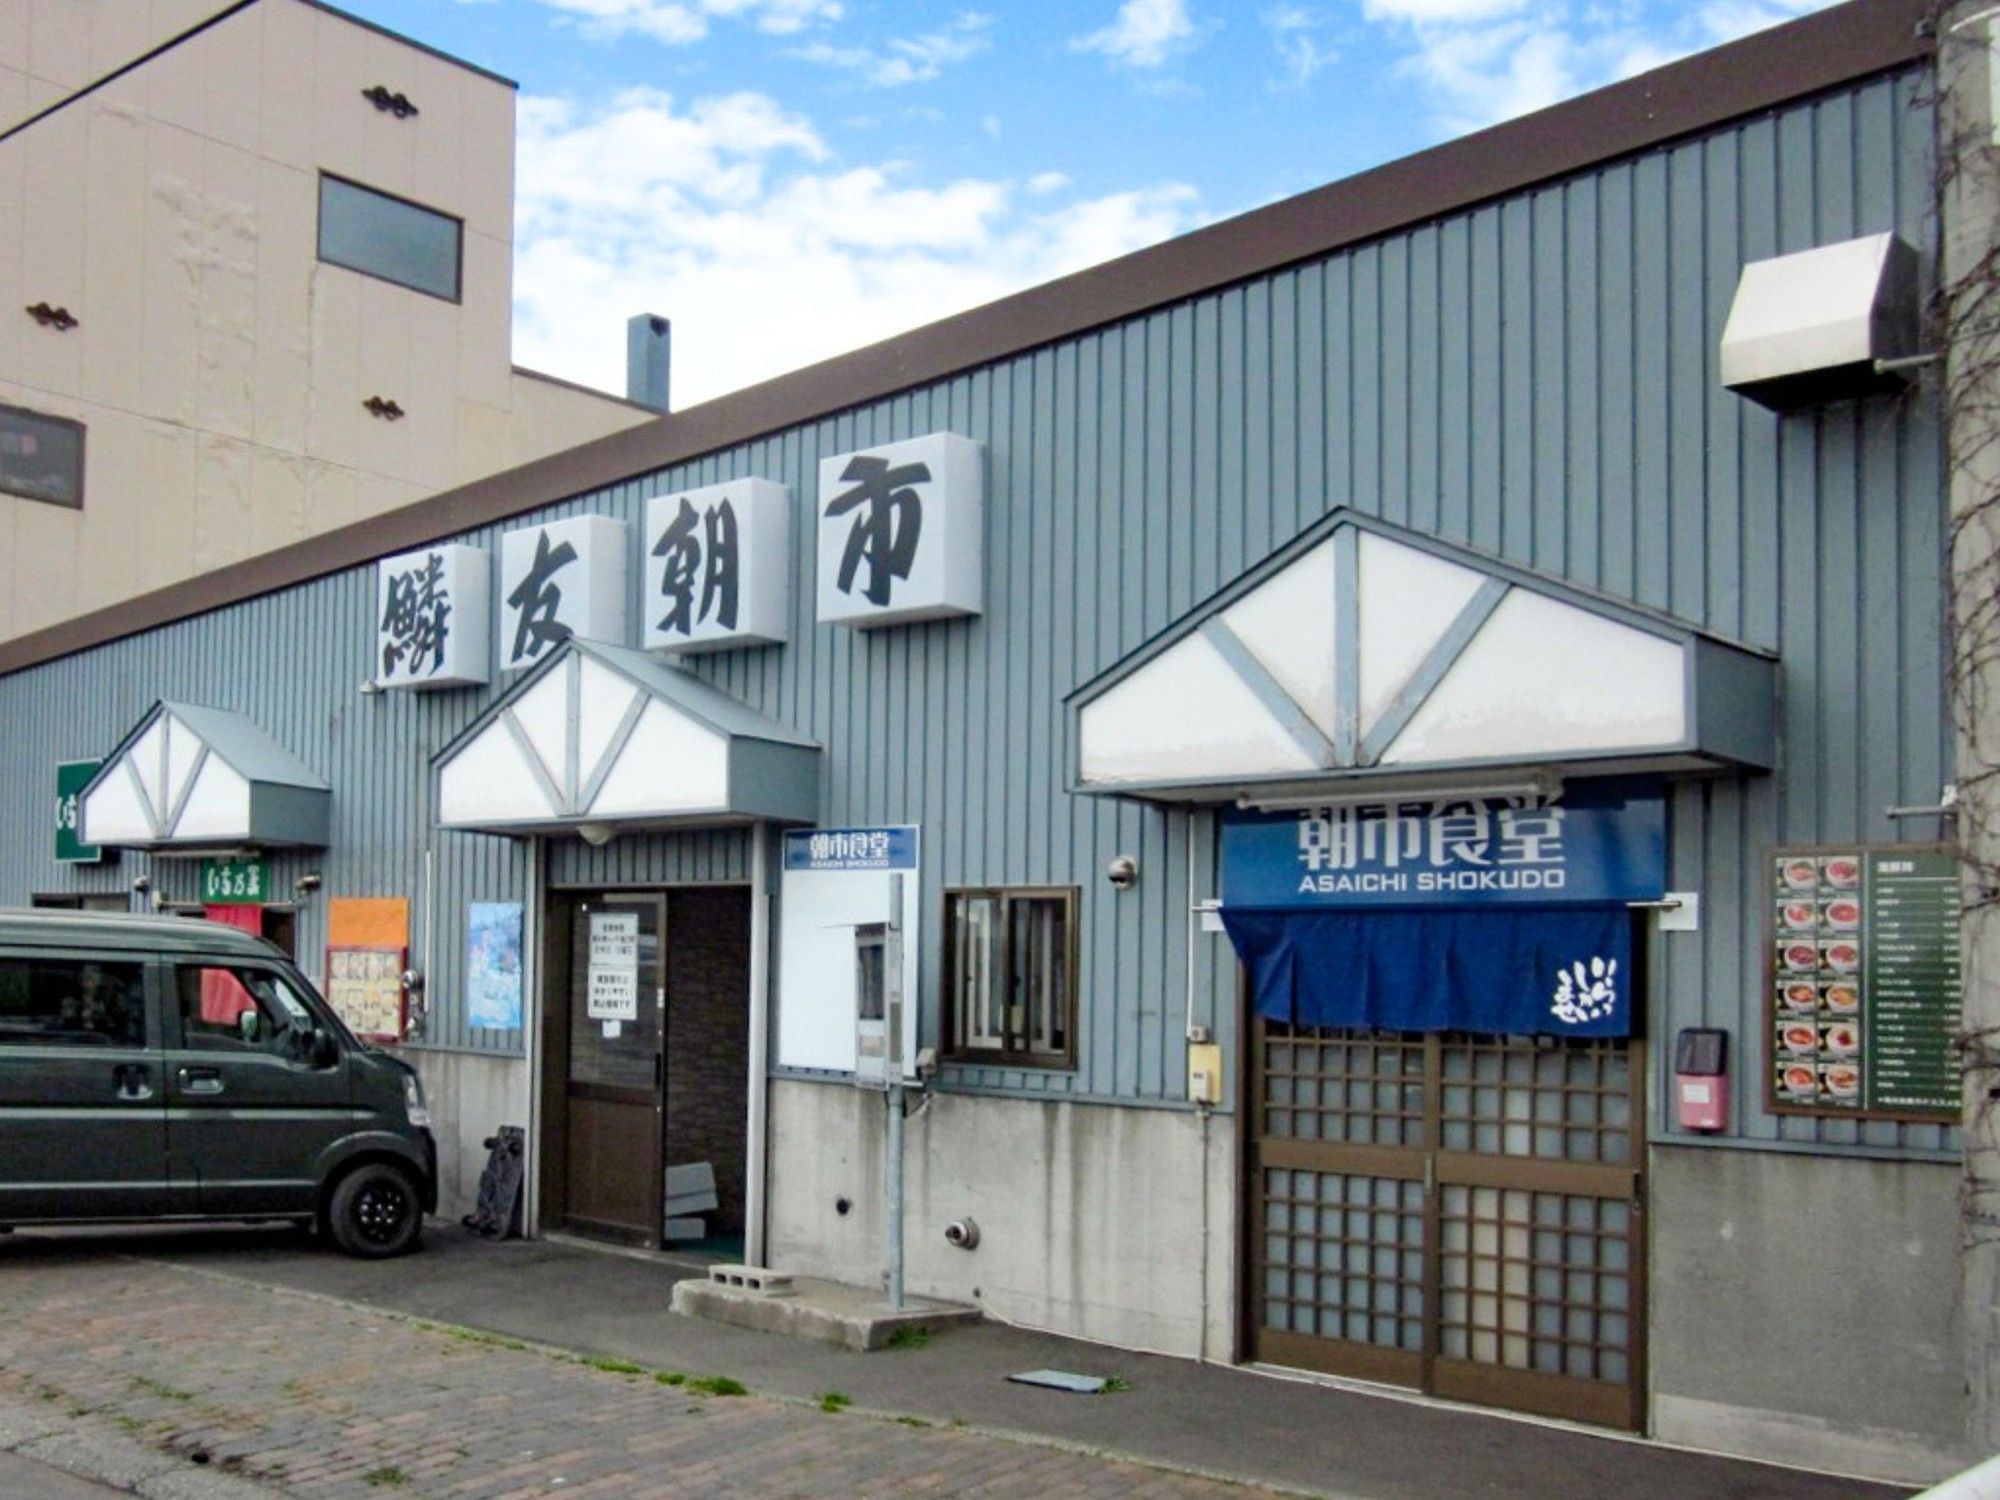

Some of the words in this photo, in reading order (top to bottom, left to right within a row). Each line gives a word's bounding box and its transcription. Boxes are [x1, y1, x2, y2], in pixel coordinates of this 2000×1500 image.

[381, 455, 932, 677] 鱗友朝市
[809, 831, 889, 859] 朝市食堂
[1298, 797, 1566, 870] 朝市食堂
[1298, 873, 1407, 893] ASAICHI
[1417, 868, 1566, 891] SHOKUDO
